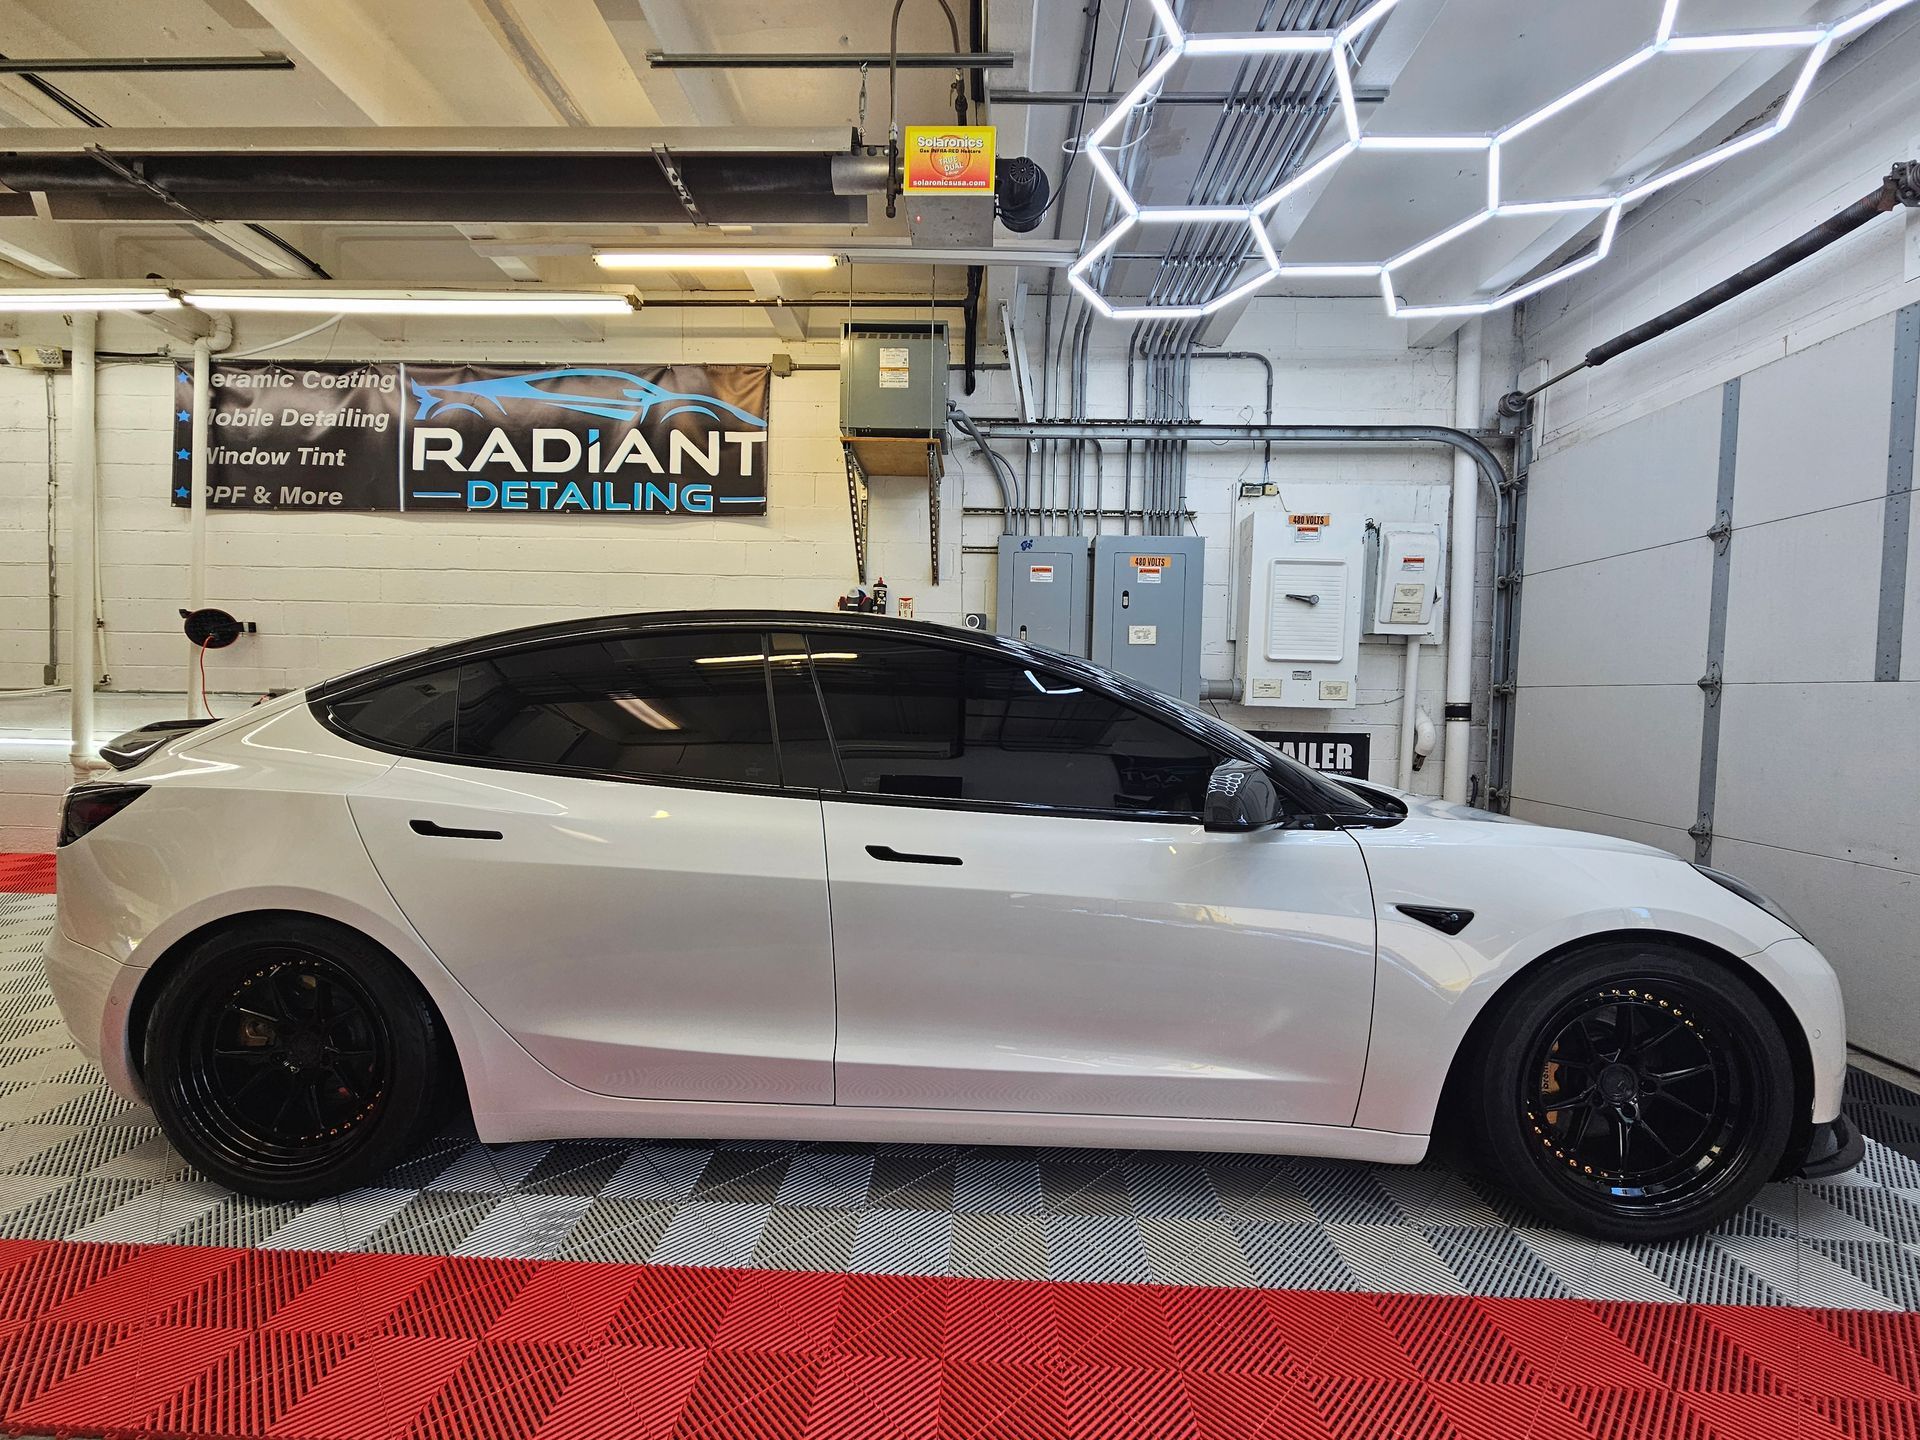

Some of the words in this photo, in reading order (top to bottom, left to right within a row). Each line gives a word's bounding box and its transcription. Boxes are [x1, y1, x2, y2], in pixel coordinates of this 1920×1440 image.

[917, 136, 984, 148] Solaronics
[913, 179, 986, 187] solaronicsusa.com
[210, 370, 295, 389] eramic
[302, 370, 397, 393] Coating
[281, 408, 390, 433] Detailing
[297, 447, 347, 467] Tint
[253, 485, 271, 504] &
[279, 486, 343, 505] More
[467, 479, 714, 513] DETAILING
[1293, 515, 1304, 525] 480
[1306, 515, 1325, 525] VOLTS
[1135, 557, 1146, 566] 480
[1148, 557, 1165, 567] VOLTS
